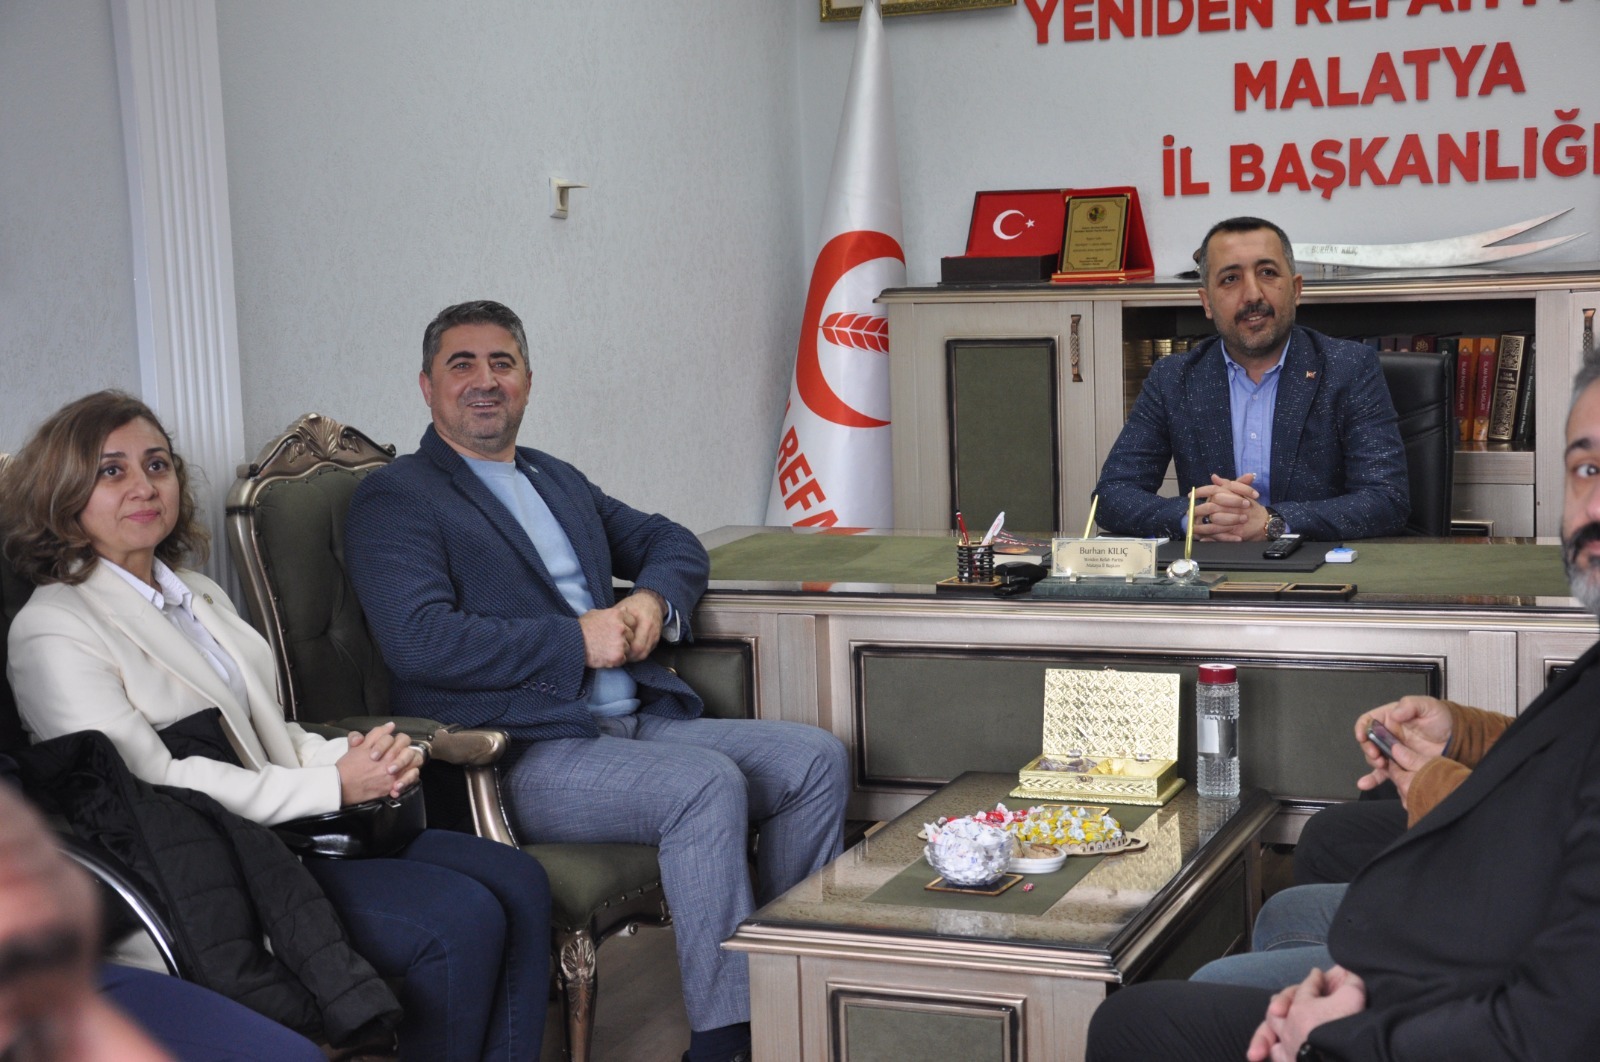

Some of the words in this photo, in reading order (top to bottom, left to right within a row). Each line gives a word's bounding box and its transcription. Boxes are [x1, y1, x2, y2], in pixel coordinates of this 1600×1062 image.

[1234, 42, 1526, 112] MALATYA
[1162, 134, 1209, 196] İL
[1080, 547, 1105, 555] Burhan
[1108, 547, 1128, 557] KILIÇ
